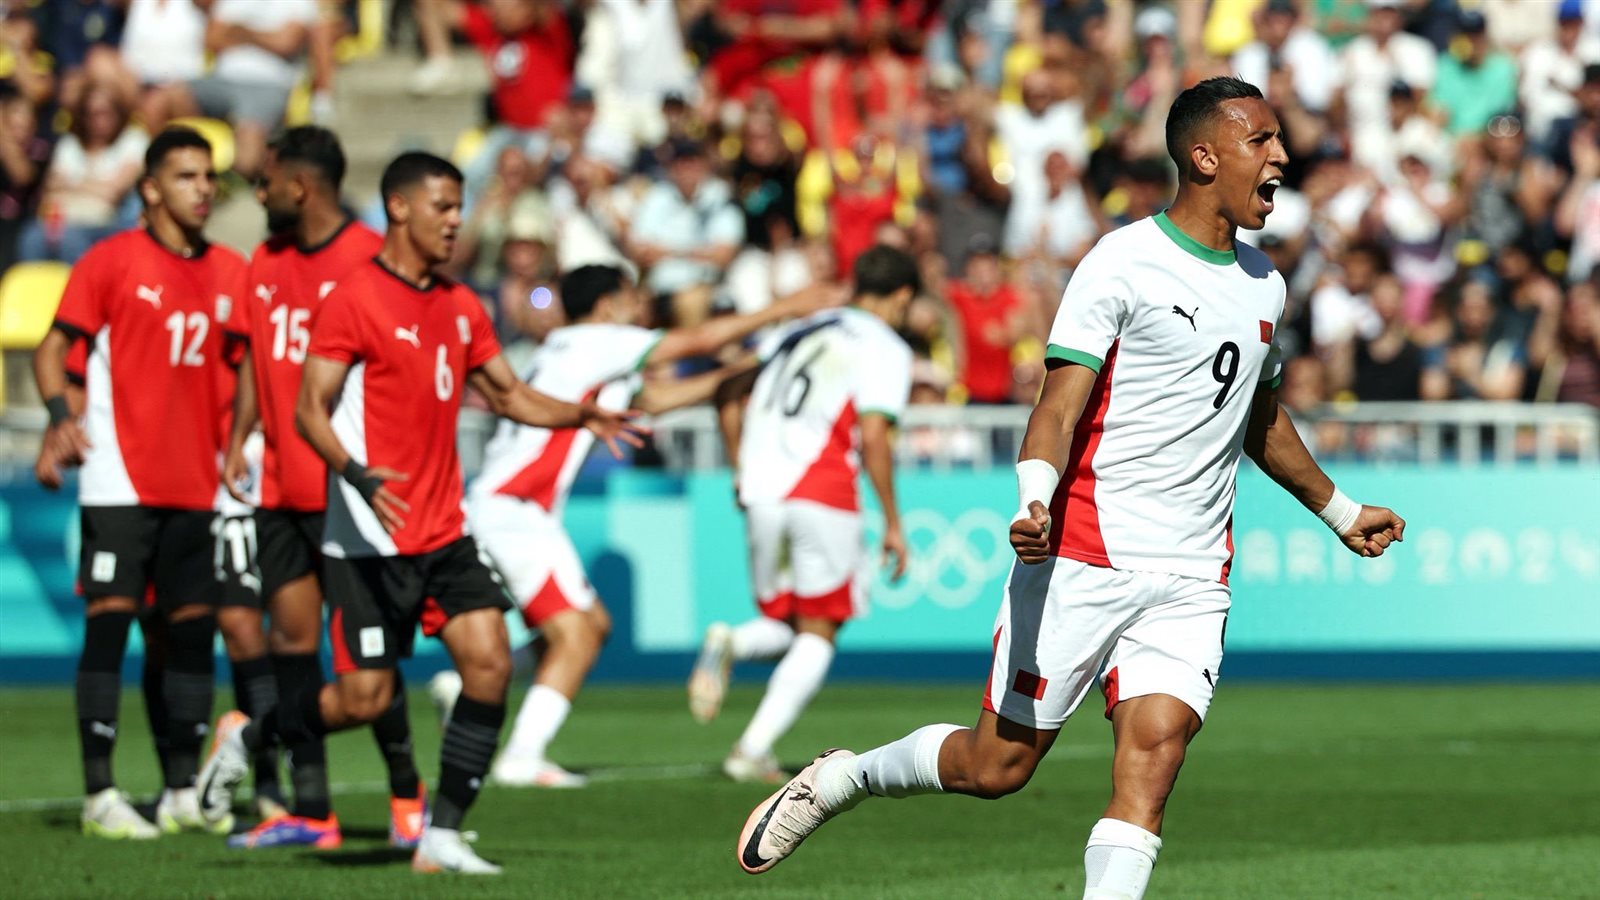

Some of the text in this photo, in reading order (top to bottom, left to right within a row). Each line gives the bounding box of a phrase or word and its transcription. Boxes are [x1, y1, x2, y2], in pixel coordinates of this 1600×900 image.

[165, 310, 210, 367] 12
[269, 303, 311, 364] 15
[435, 343, 454, 401] 6
[763, 340, 828, 418] 16
[1212, 341, 1240, 409] 9
[1240, 527, 1600, 585] ARIS 2024
